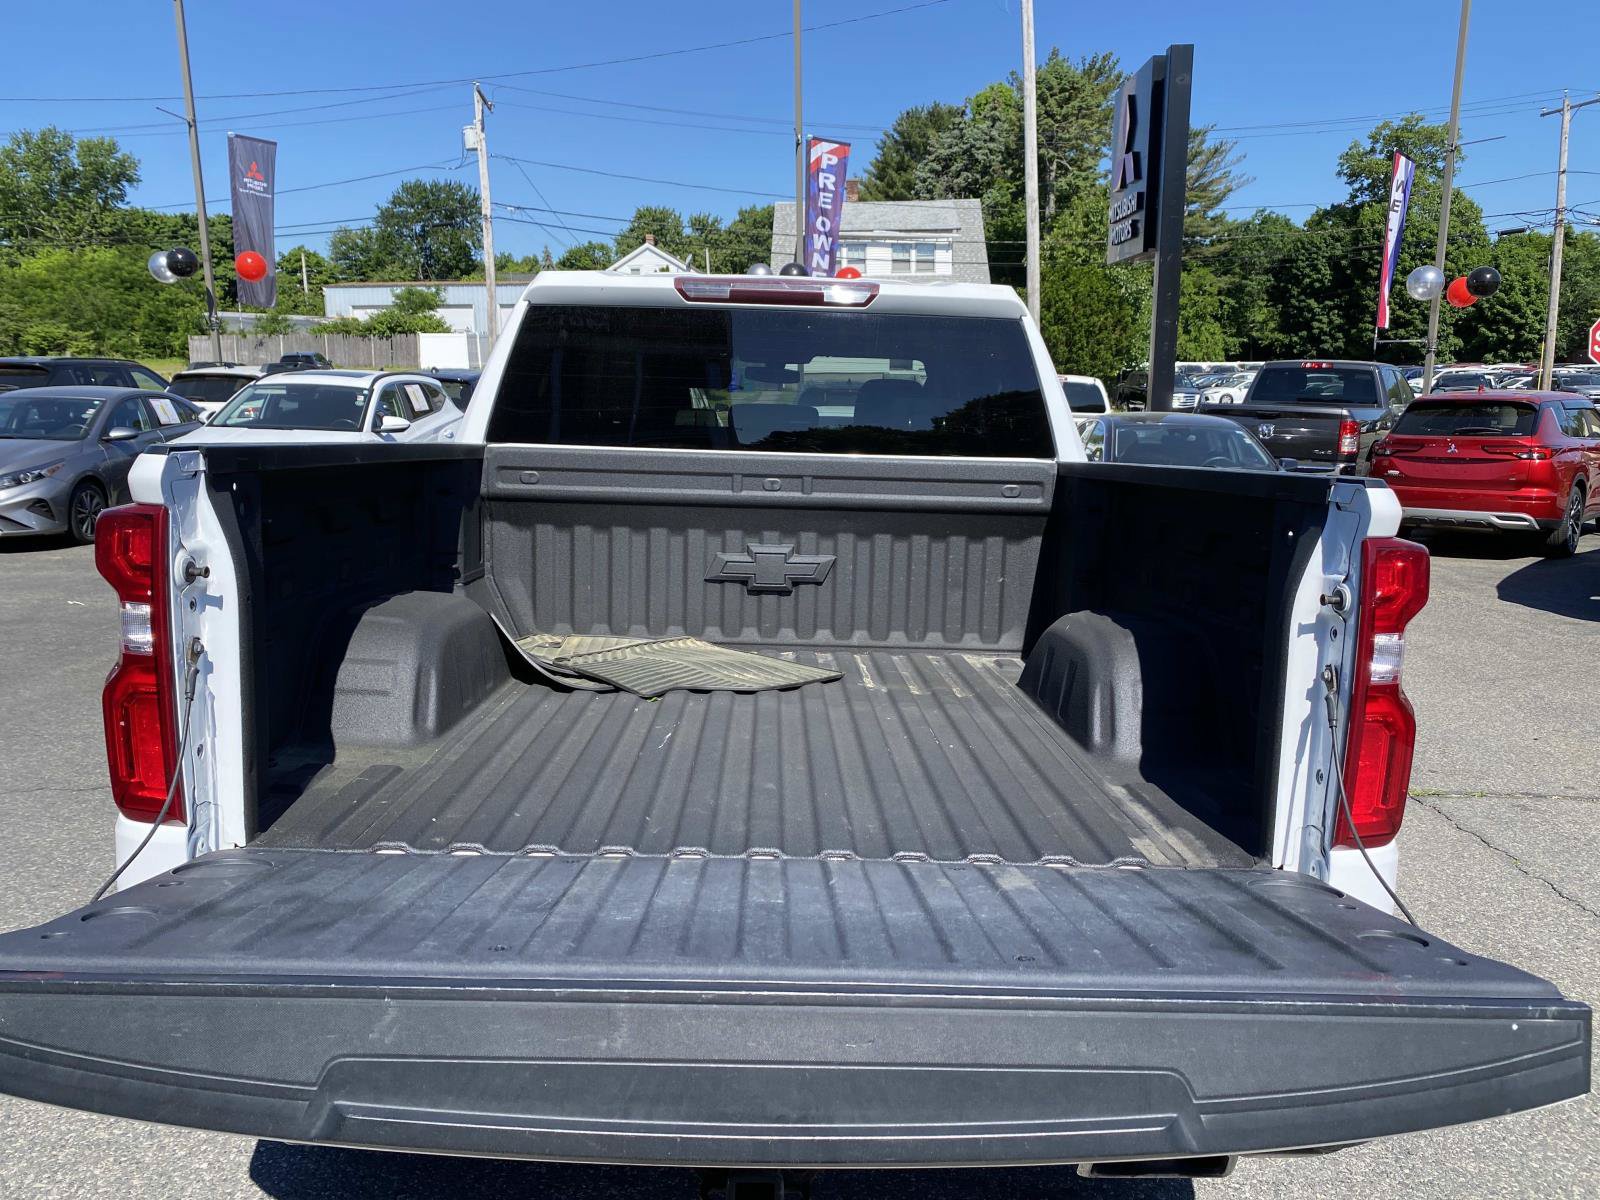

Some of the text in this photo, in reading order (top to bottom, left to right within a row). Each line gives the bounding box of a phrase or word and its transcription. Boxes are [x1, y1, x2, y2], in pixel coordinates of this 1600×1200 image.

[811, 152, 838, 278] PRE OWN
[1109, 192, 1137, 224] MITSUBISHI
[1111, 219, 1132, 246] MOTORS
